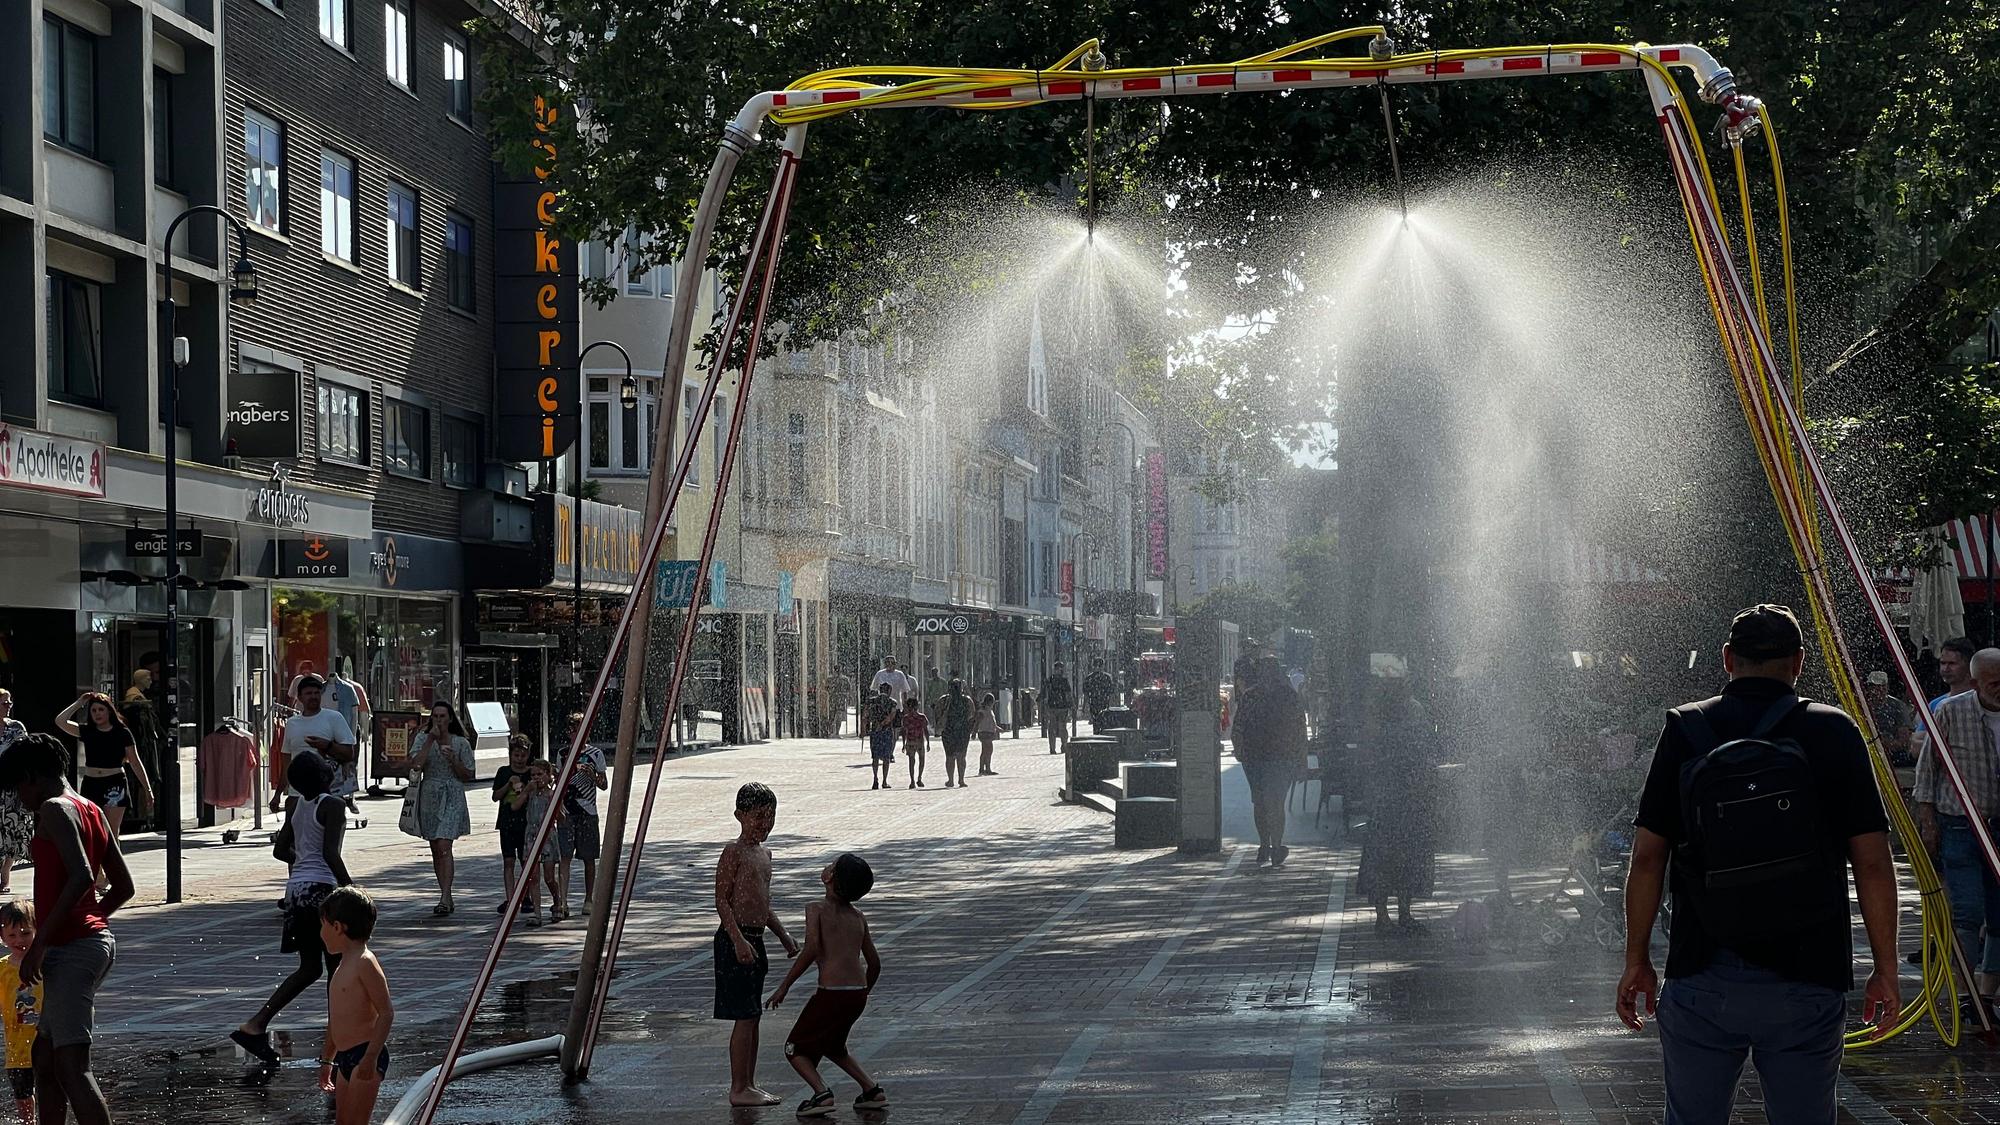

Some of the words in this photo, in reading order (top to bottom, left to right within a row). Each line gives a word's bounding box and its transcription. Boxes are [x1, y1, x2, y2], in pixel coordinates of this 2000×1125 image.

[227, 407, 290, 425] ngbers
[16, 437, 84, 484] Apotheke
[258, 481, 309, 528] engbers
[134, 538, 193, 553] engbrs
[557, 503, 640, 574] Mrzenich
[297, 564, 337, 574] more
[914, 618, 951, 632] AOK
